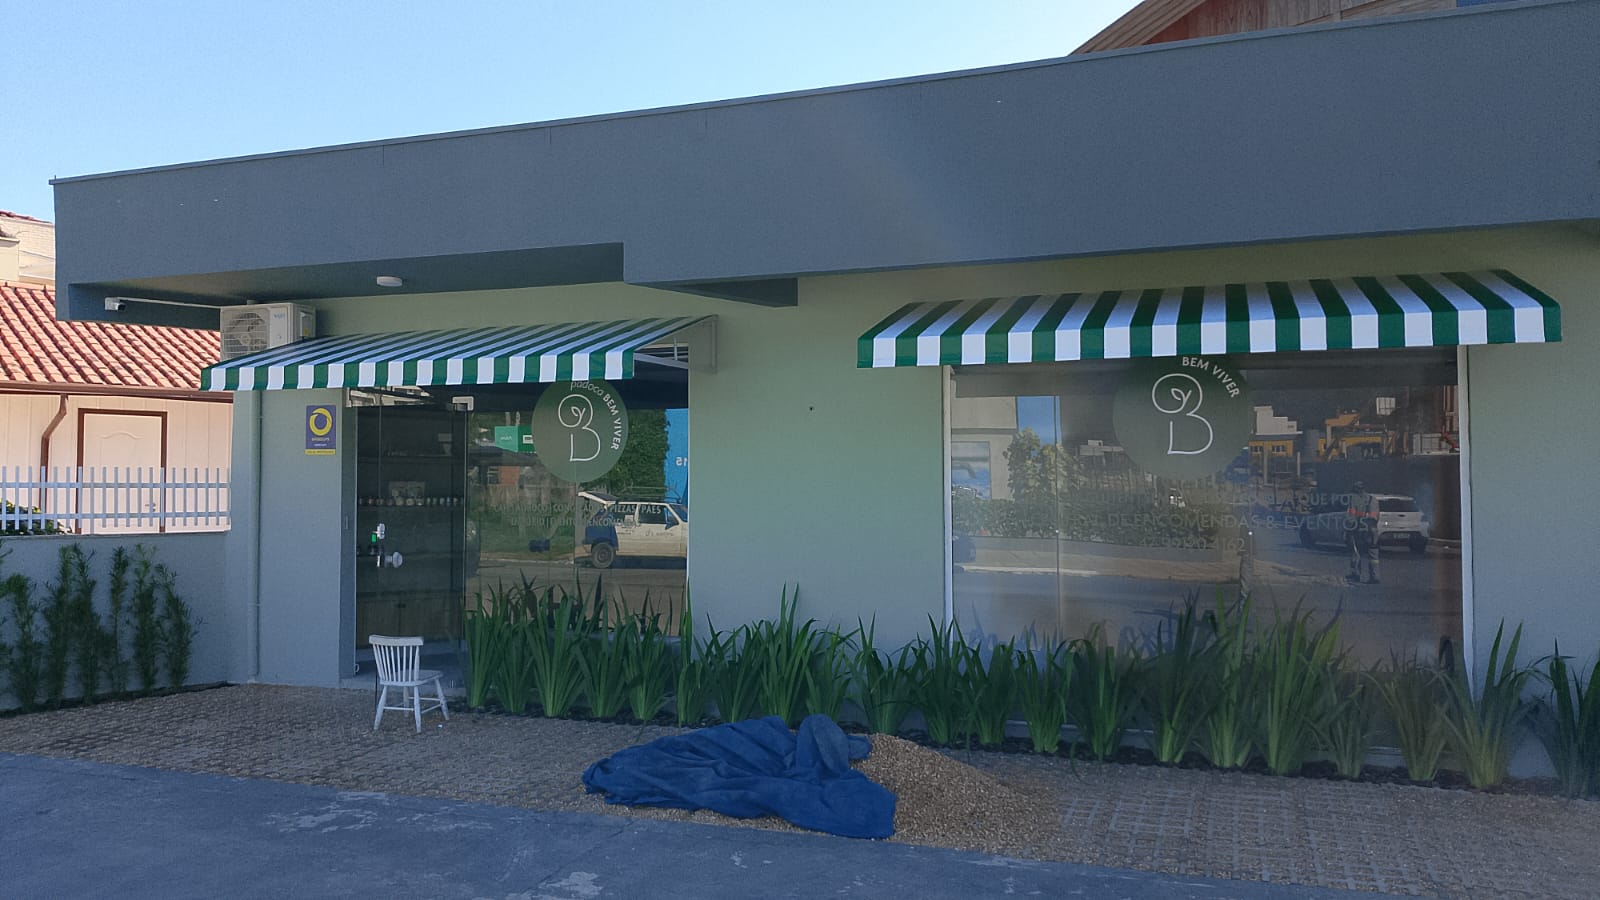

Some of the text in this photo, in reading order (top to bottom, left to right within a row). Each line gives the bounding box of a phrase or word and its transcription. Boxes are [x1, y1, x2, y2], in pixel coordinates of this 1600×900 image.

[1181, 356, 1240, 399] BEM VIVER
[570, 380, 622, 451] padoca BEM VIVER
[1284, 514, 1369, 531] EVENTOS
